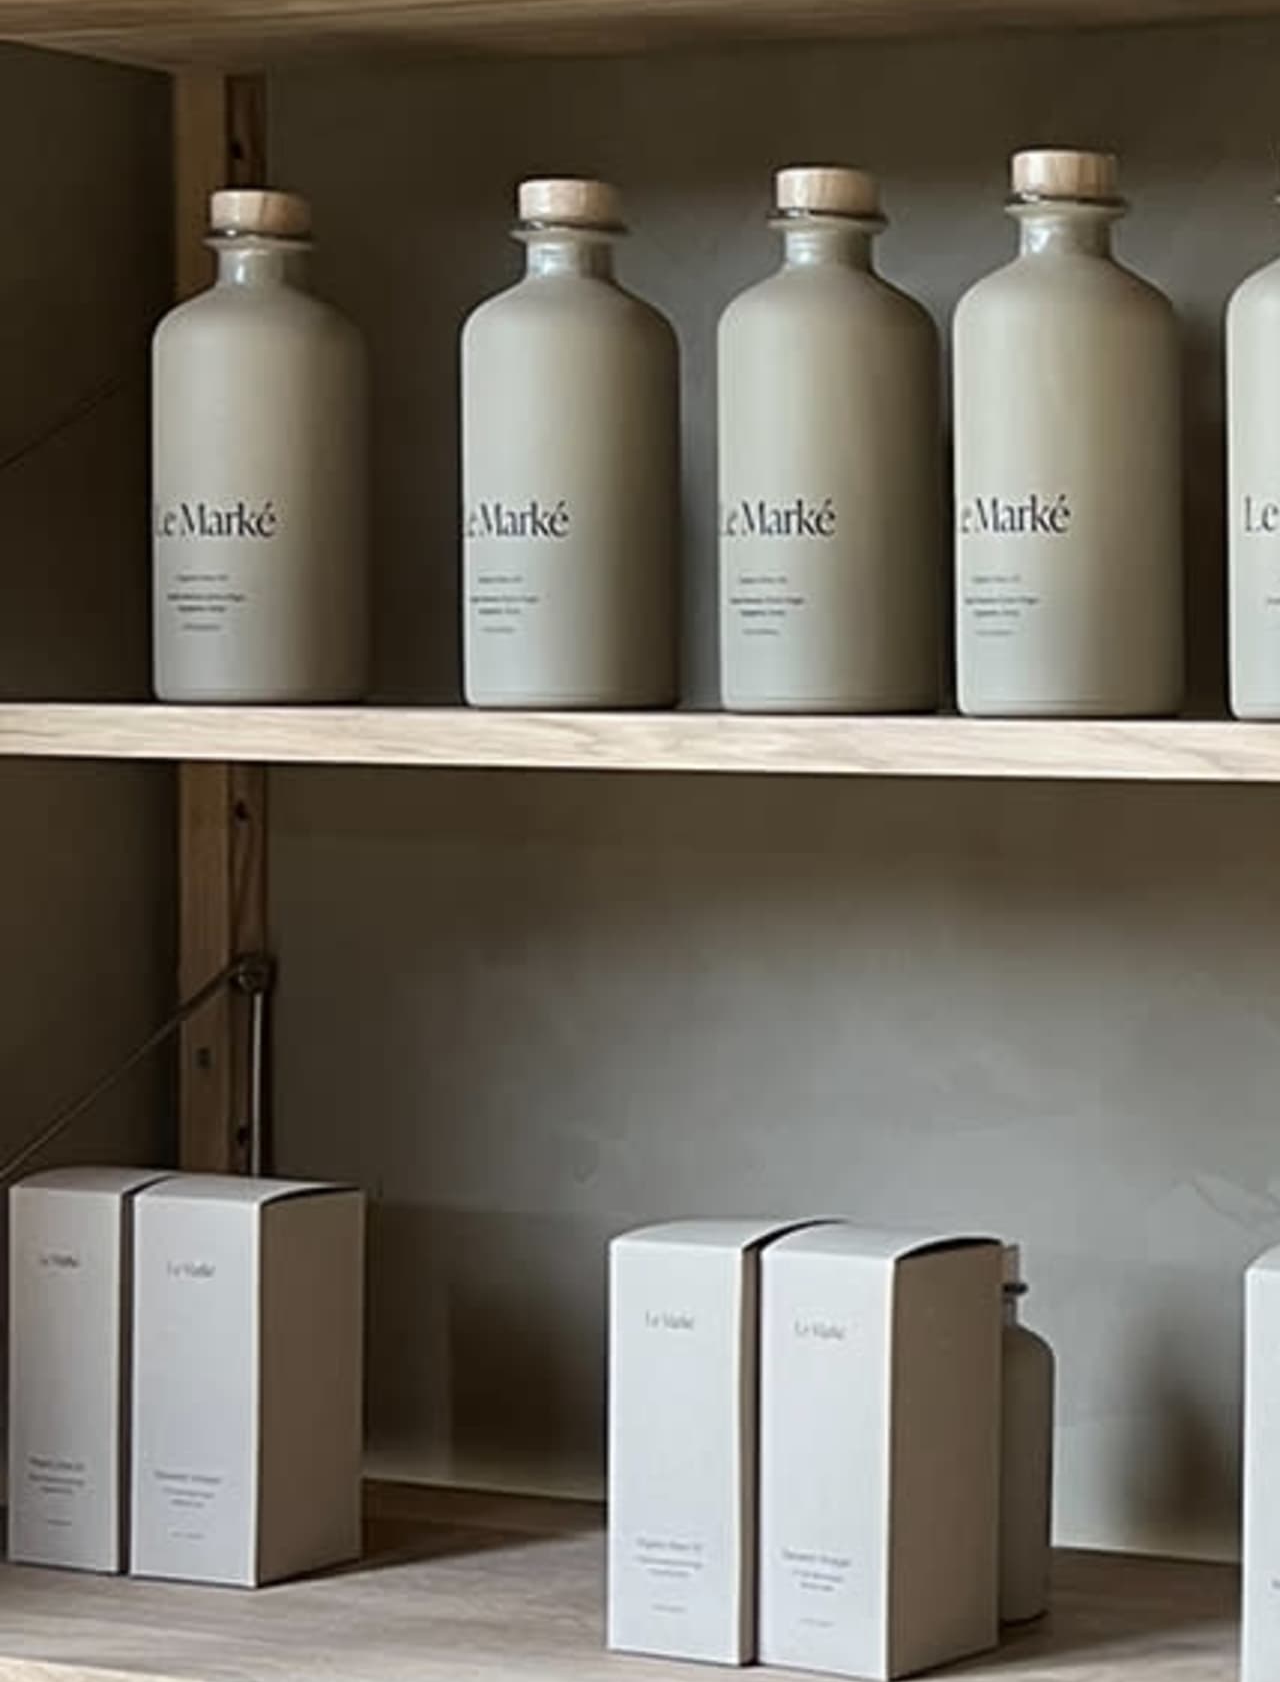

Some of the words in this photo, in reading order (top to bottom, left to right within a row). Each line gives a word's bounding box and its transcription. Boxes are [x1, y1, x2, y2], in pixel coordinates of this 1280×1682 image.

[179, 500, 277, 538] Marké
[479, 500, 570, 538] Marké
[741, 498, 837, 537] Marké
[974, 494, 1071, 534] Marké
[1243, 493, 1280, 534] Le
